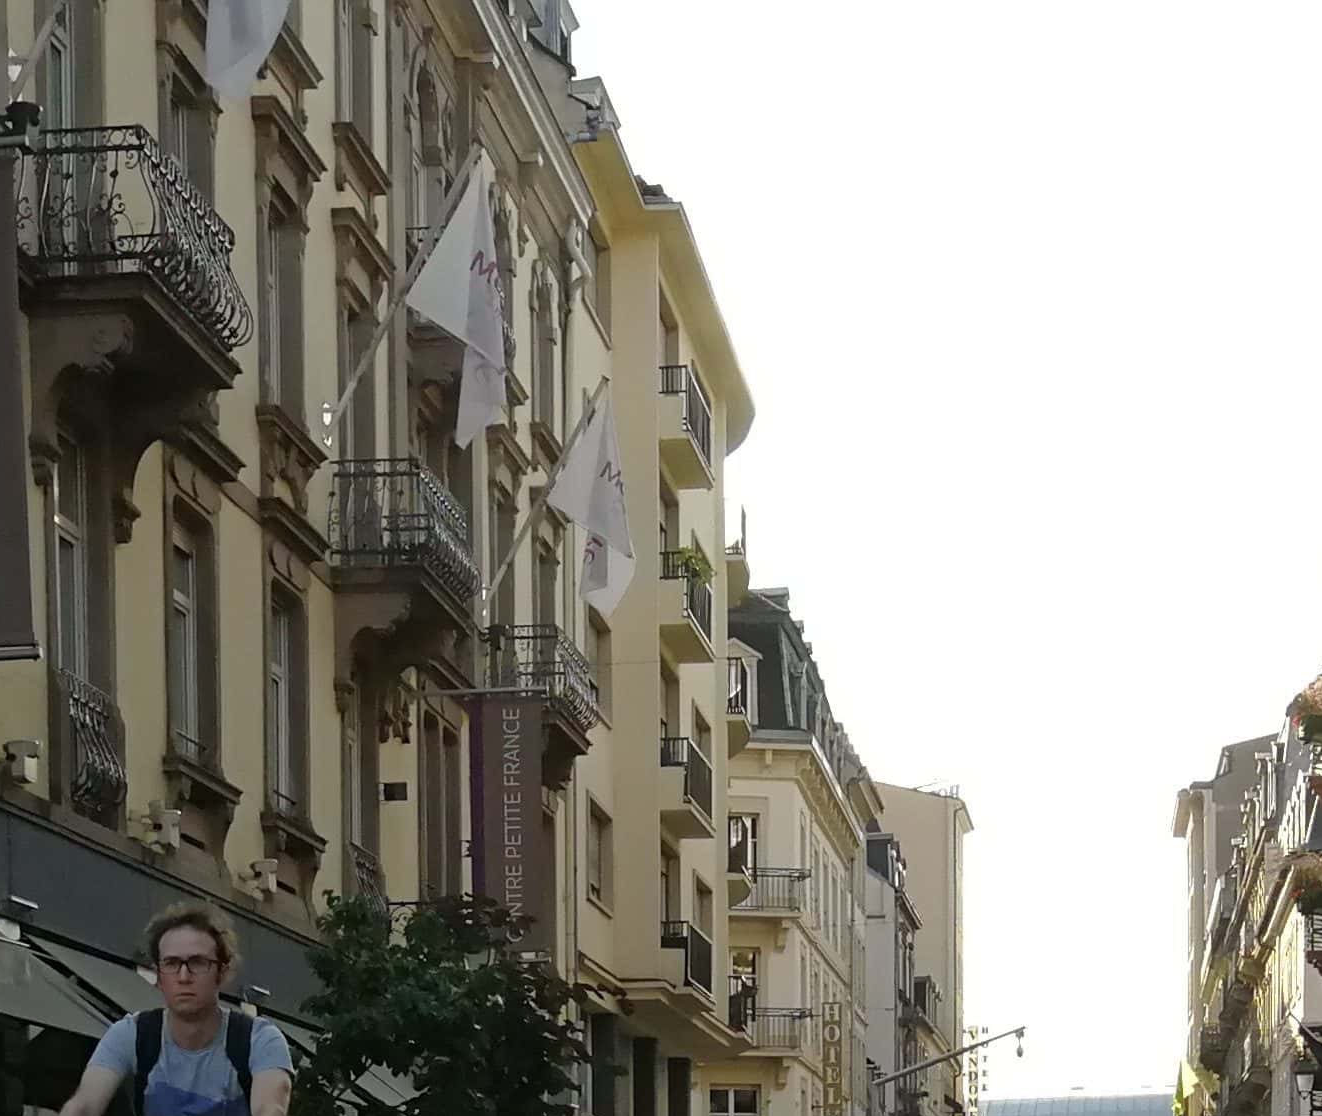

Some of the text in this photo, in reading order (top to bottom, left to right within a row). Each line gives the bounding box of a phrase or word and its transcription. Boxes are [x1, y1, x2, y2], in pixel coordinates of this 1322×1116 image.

[502, 708, 523, 943] CNTRE PETITE FRANCE
[824, 1003, 842, 1105] HOTEL
